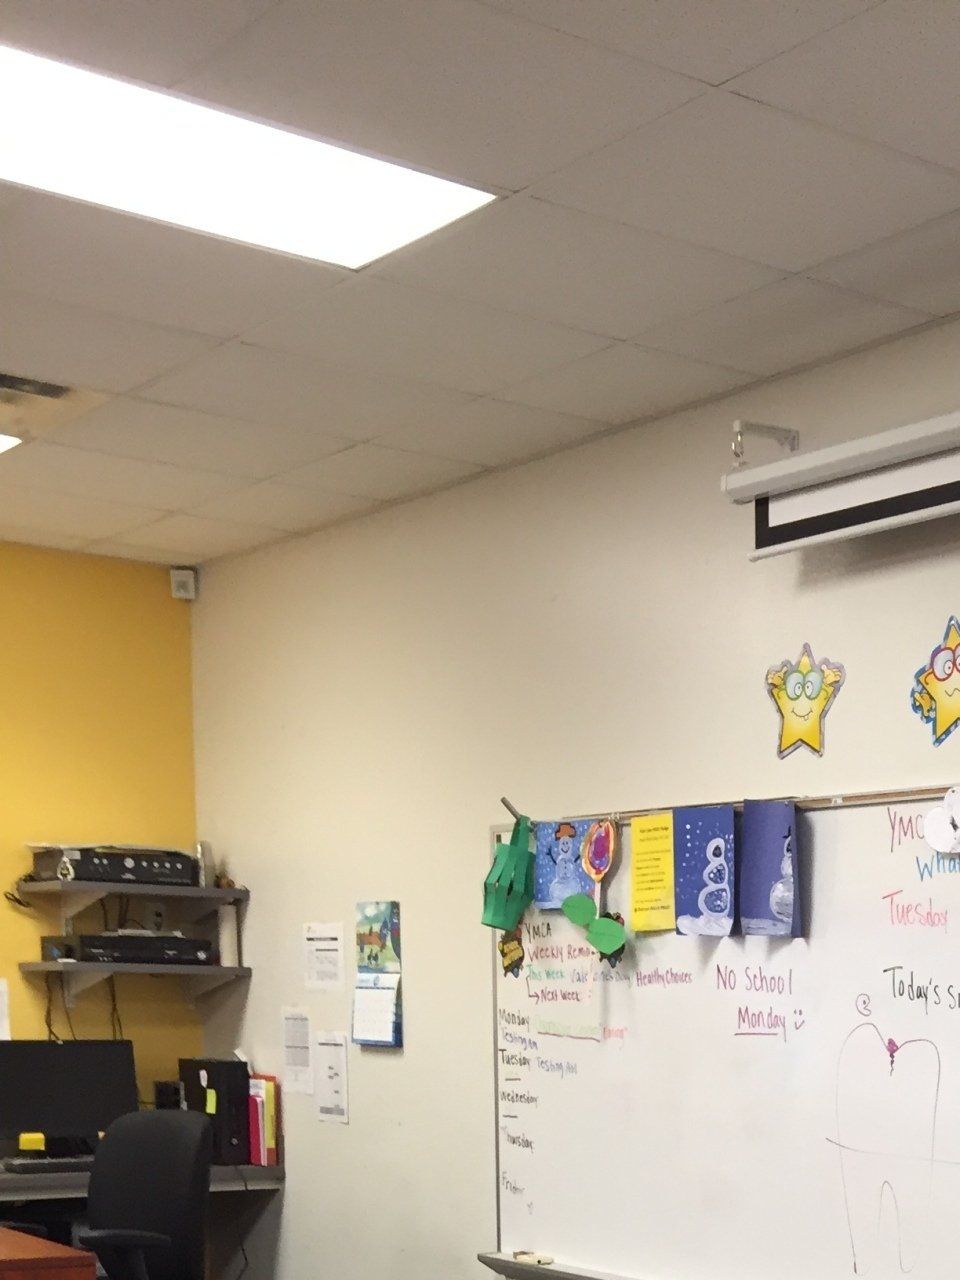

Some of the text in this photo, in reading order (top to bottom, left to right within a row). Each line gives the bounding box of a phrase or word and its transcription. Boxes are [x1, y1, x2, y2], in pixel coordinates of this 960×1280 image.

[886, 806, 925, 853] YMC
[882, 890, 948, 934] Tuesday
[524, 921, 552, 944] YMCA
[744, 966, 792, 995] School
[882, 966, 941, 1015] Today's
[499, 1008, 530, 1033] Monday
[737, 1005, 787, 1043] Monday
[498, 1048, 531, 1072] Tuesday
